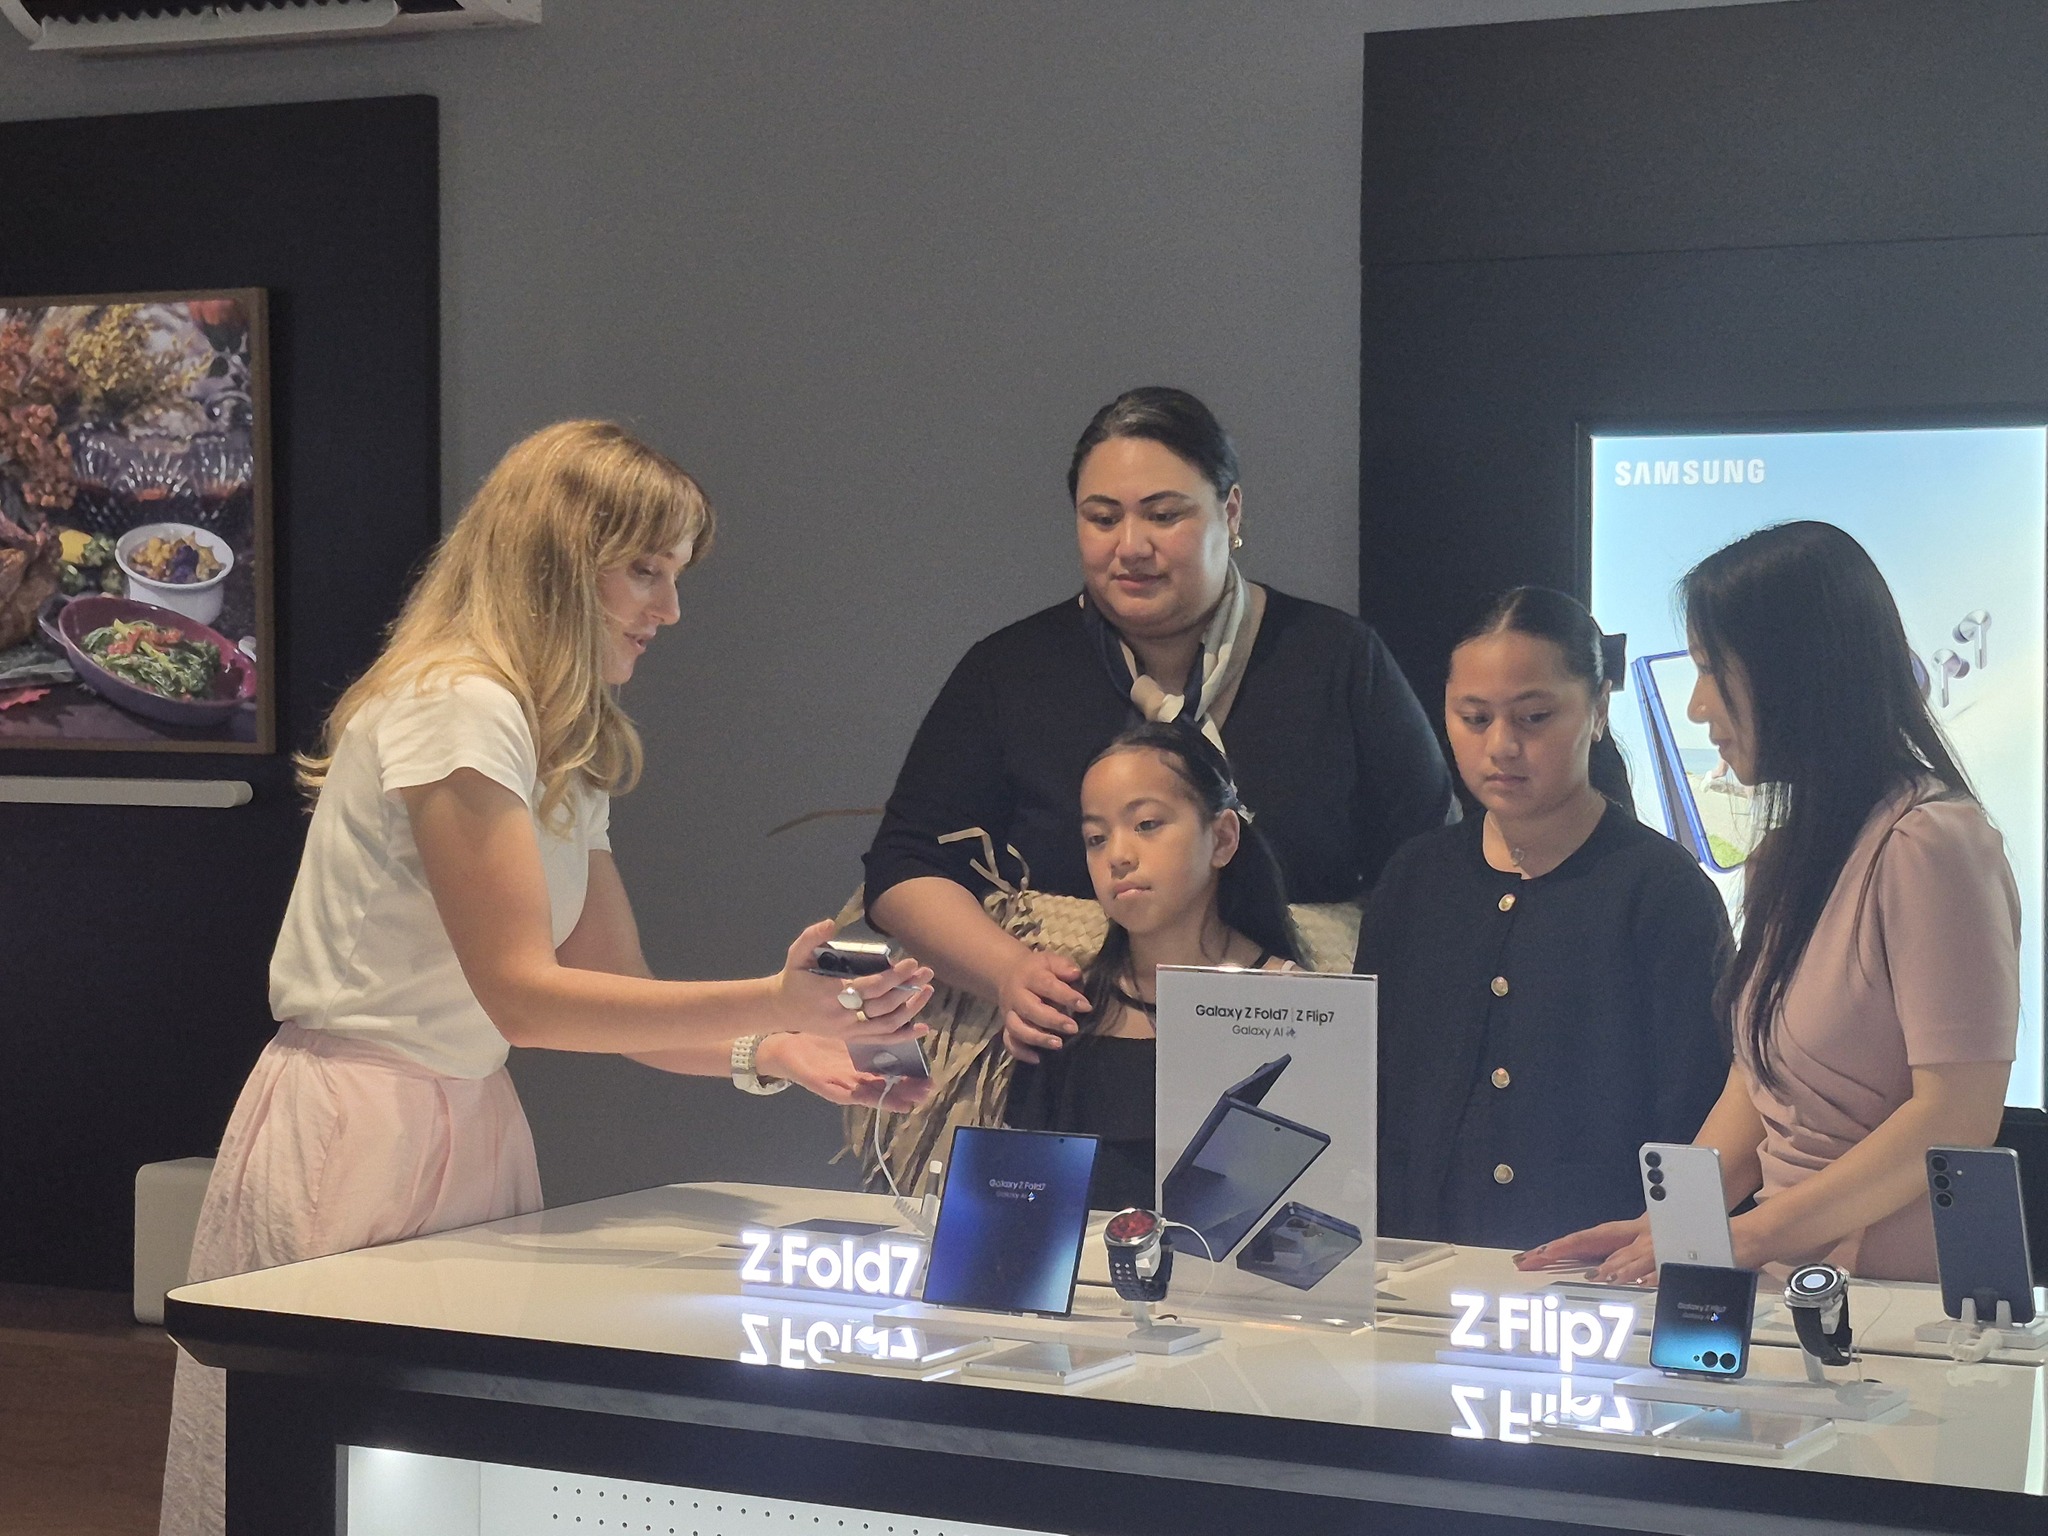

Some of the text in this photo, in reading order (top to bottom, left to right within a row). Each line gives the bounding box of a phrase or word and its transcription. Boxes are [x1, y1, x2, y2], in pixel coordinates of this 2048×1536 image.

[1614, 458, 1766, 486] SAMSUNG
[1195, 1004, 1335, 1026] Galaxy Z Fold7 Z Flip7
[1232, 1024, 1284, 1039] Galaxy AI
[741, 1232, 920, 1297] Z Fold7
[1450, 1293, 1634, 1373] Z Flip7
